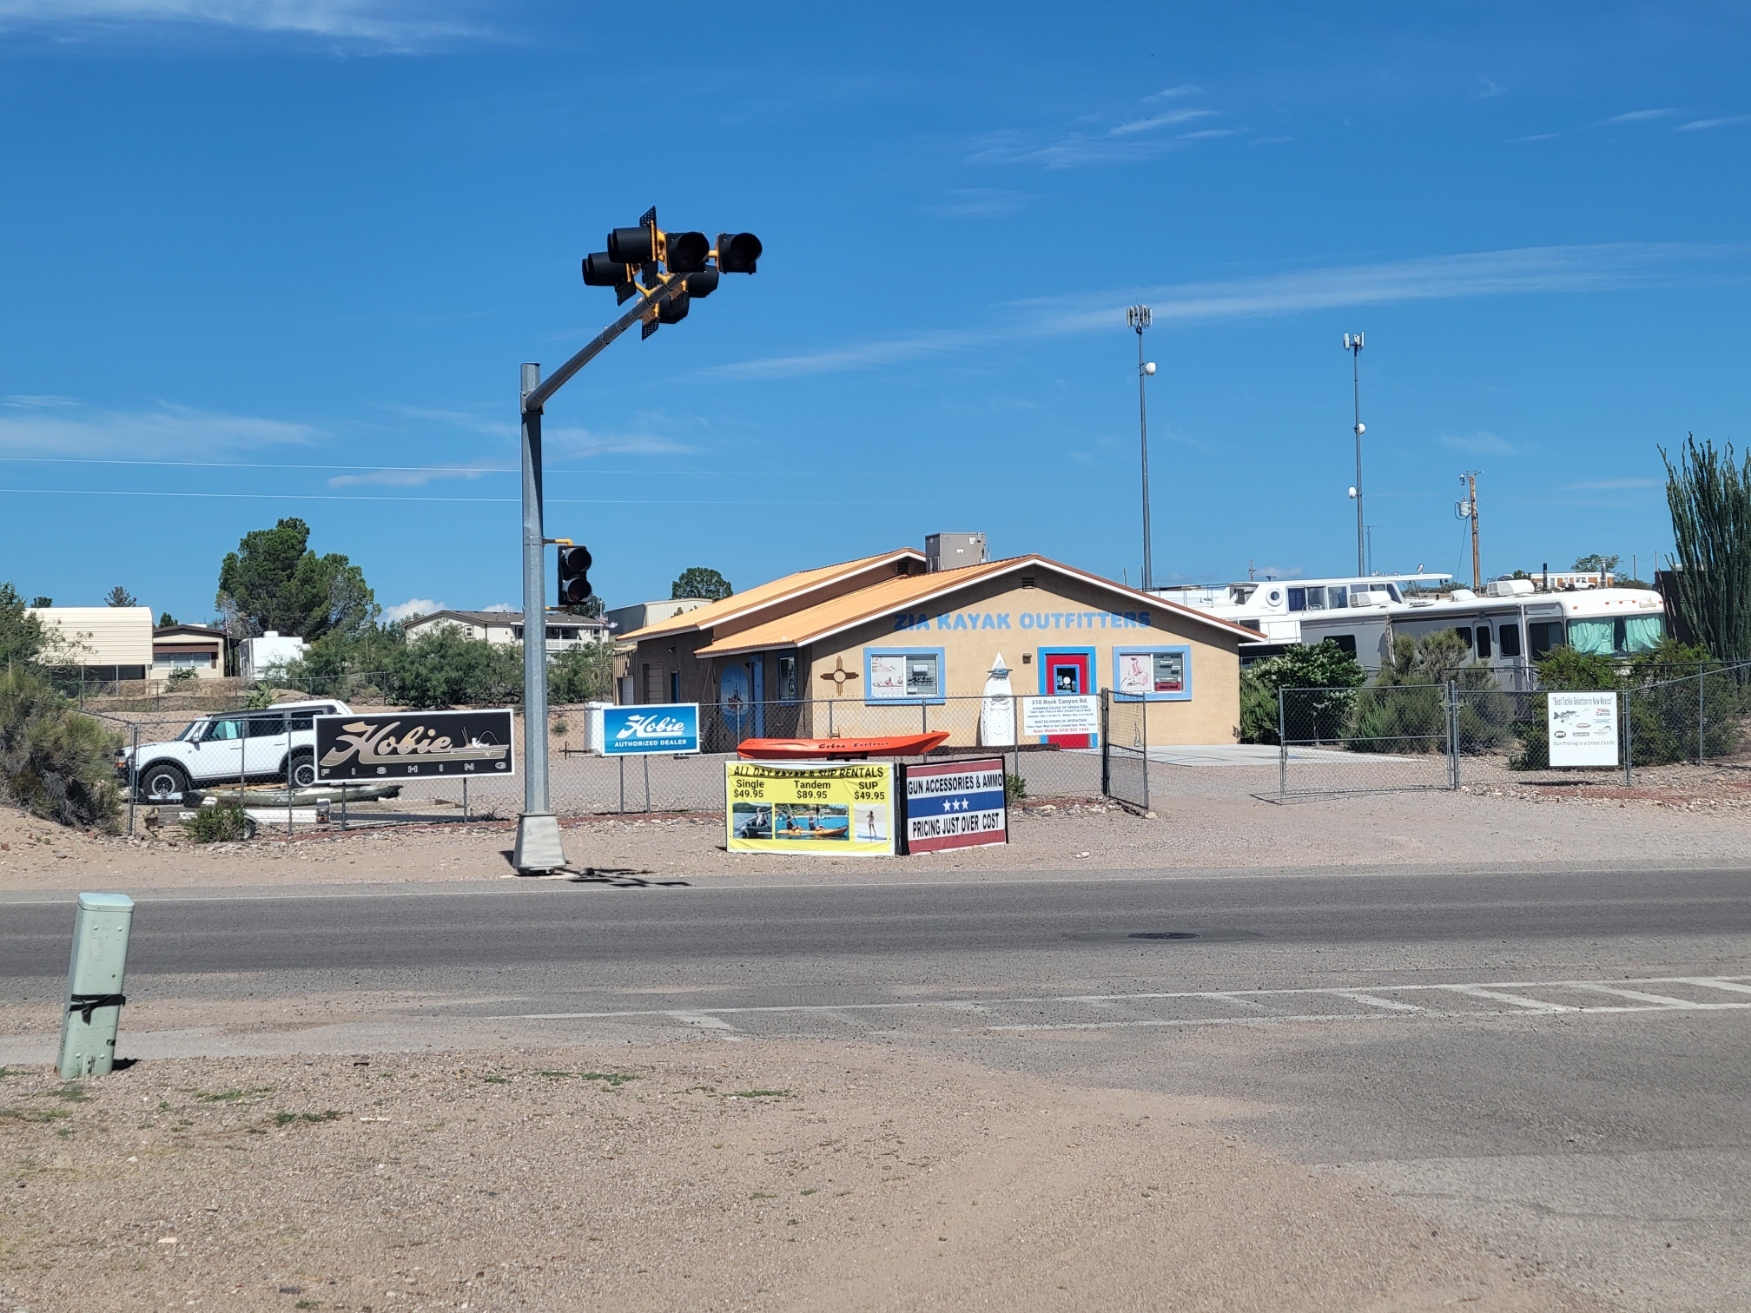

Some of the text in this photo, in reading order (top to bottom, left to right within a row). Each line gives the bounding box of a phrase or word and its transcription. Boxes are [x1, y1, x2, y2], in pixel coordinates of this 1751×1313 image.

[893, 611, 1151, 632] ZIA KAYAK OUTFITTERS
[616, 714, 685, 739] Hobie
[319, 721, 453, 767] Hobie
[614, 739, 687, 748] AUTHORIZED DEALER
[320, 762, 507, 777] FISHING
[734, 765, 750, 776] ALL
[753, 767, 773, 778] DAY
[819, 769, 837, 778] SUP
[839, 766, 884, 778] RENTALS
[736, 779, 765, 790] Single
[794, 780, 831, 790] Tandem
[858, 781, 879, 790] SUP
[907, 773, 1003, 795] GUN ACCESSORIES & AMMO
[733, 789, 764, 798] $49.95
[796, 789, 828, 799] $89.95
[854, 790, 885, 800] $49.95
[912, 812, 1000, 839] PRICING JUST OVER COST
